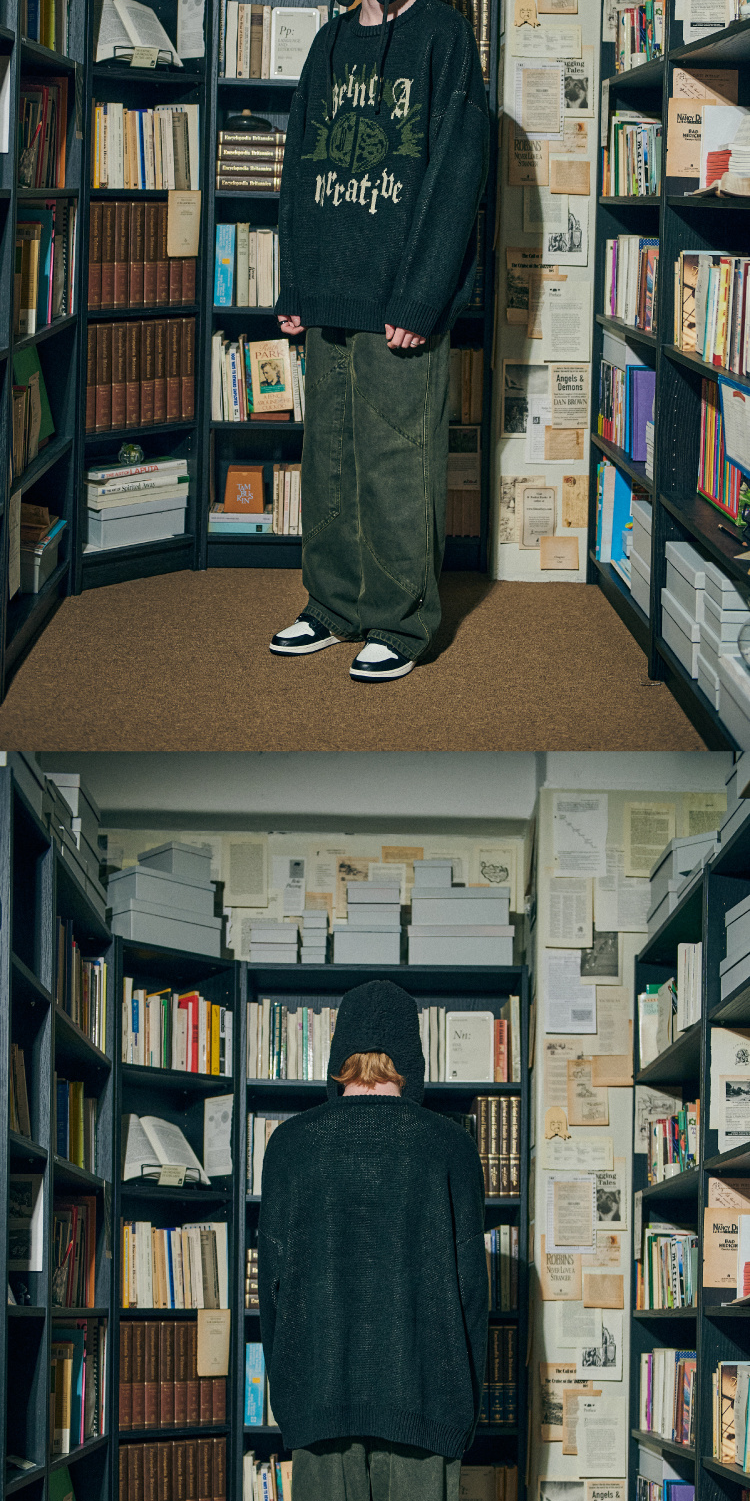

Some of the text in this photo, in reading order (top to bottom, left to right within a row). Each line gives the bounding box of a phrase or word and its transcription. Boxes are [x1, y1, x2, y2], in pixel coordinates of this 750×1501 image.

[279, 25, 295, 37] Pp:
[391, 78, 414, 120] A
[255, 350, 286, 360] PARK
[556, 374, 584, 384] Angels &
[558, 383, 583, 391] Demons
[129, 465, 159, 476] LAPUTA
[592, 1490, 620, 1500] Angels &
